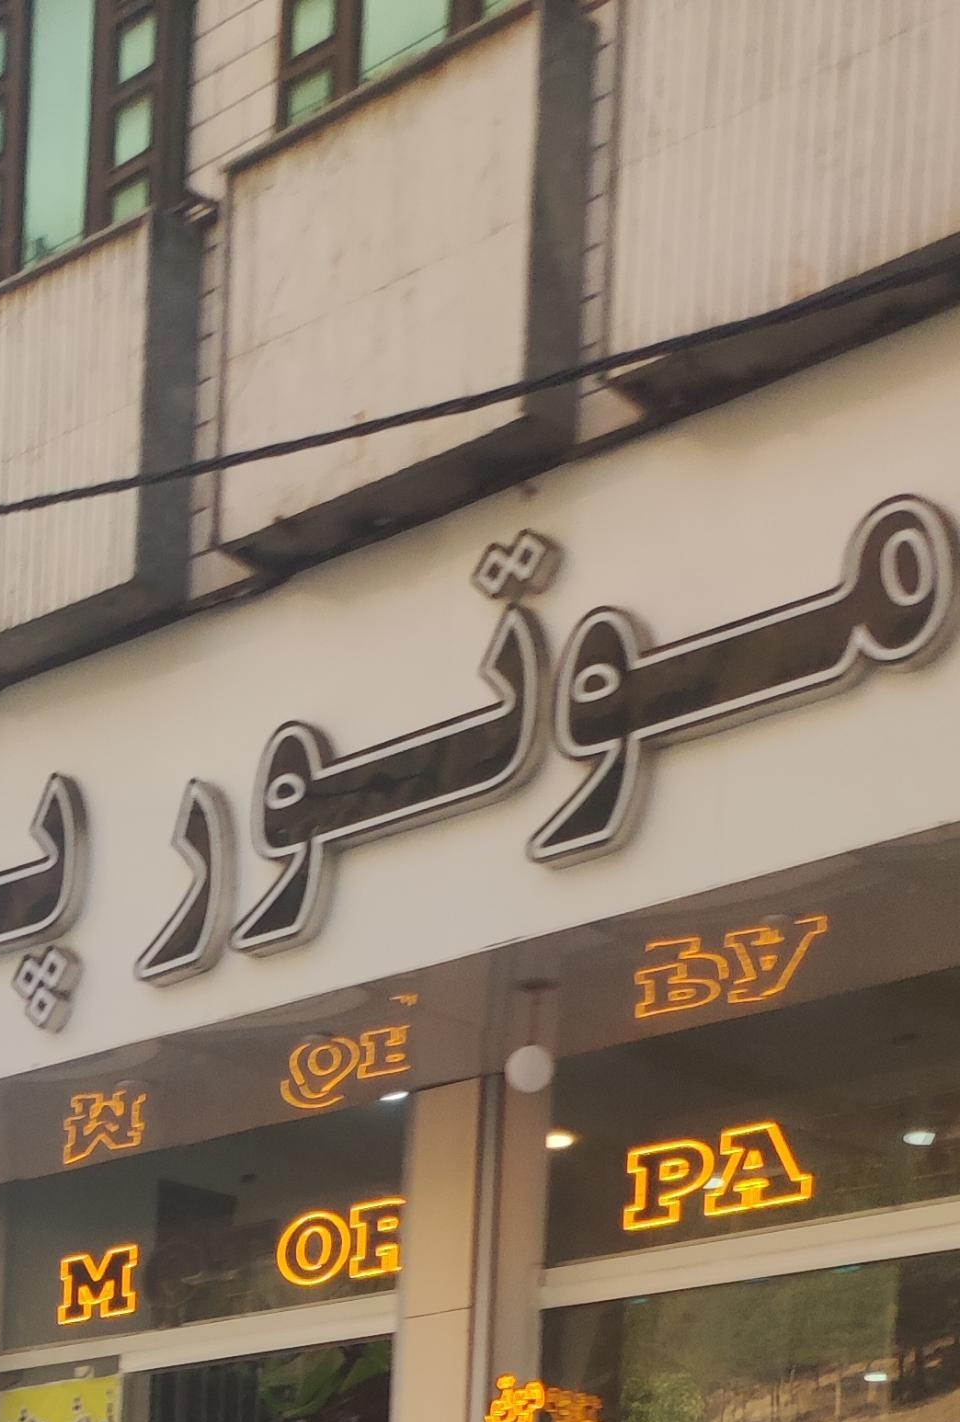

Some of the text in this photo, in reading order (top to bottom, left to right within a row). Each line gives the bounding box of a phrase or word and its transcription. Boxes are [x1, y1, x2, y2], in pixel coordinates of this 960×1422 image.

[137, 494, 955, 987] موتور
[58, 1243, 139, 1326] M
[622, 1119, 813, 1231] PA
